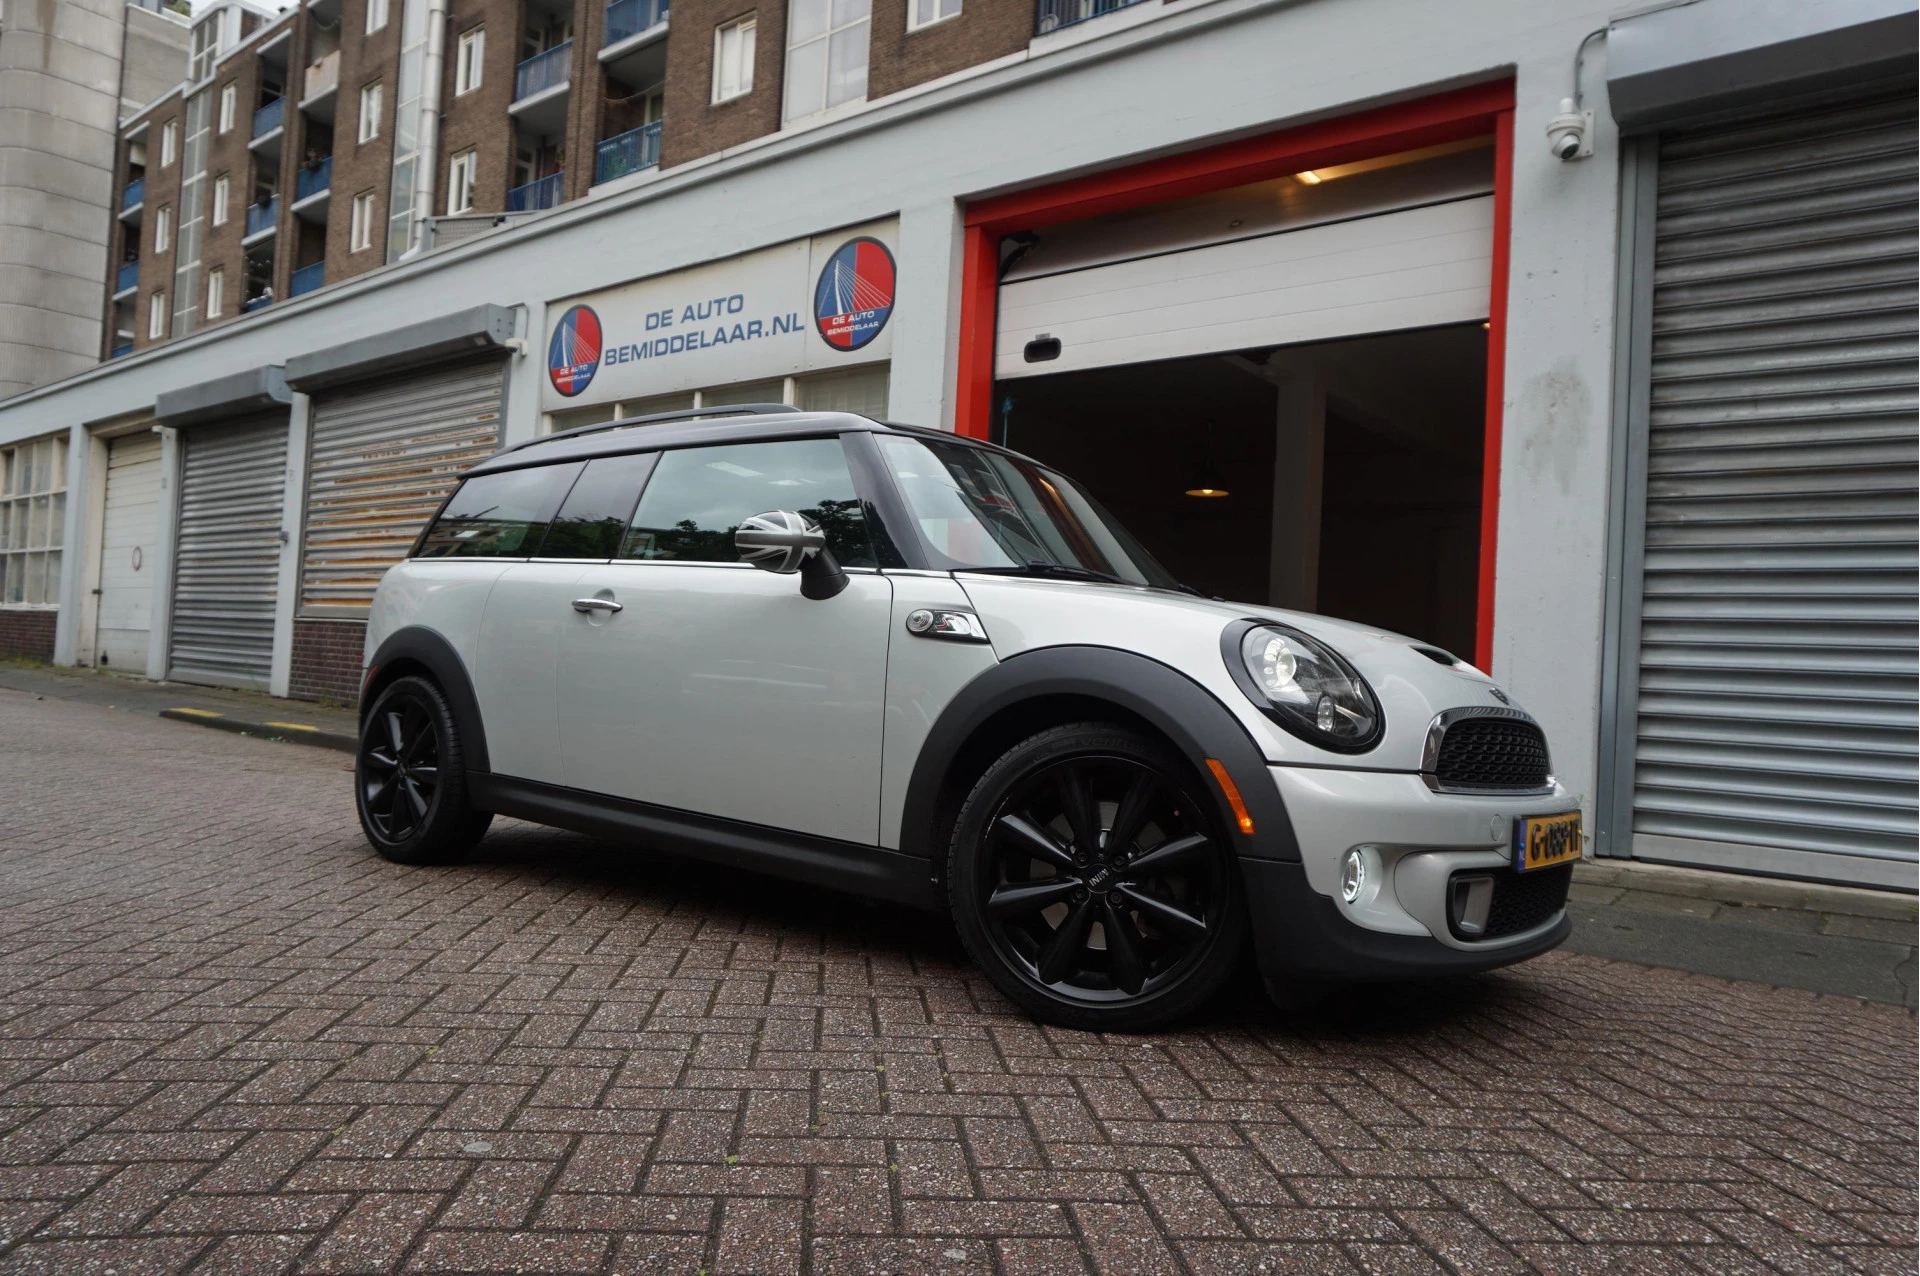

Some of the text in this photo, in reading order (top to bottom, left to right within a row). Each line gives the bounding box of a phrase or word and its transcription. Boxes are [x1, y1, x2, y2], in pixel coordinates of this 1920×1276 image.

[645, 294, 743, 331] DE AUTO
[832, 311, 875, 325] DE AUTO
[827, 321, 879, 335] BEMIDDELAAR
[604, 313, 804, 366] BEMIDDELAAR.NL
[560, 364, 588, 375] DE AUTO
[1089, 868, 1109, 887] MINI
